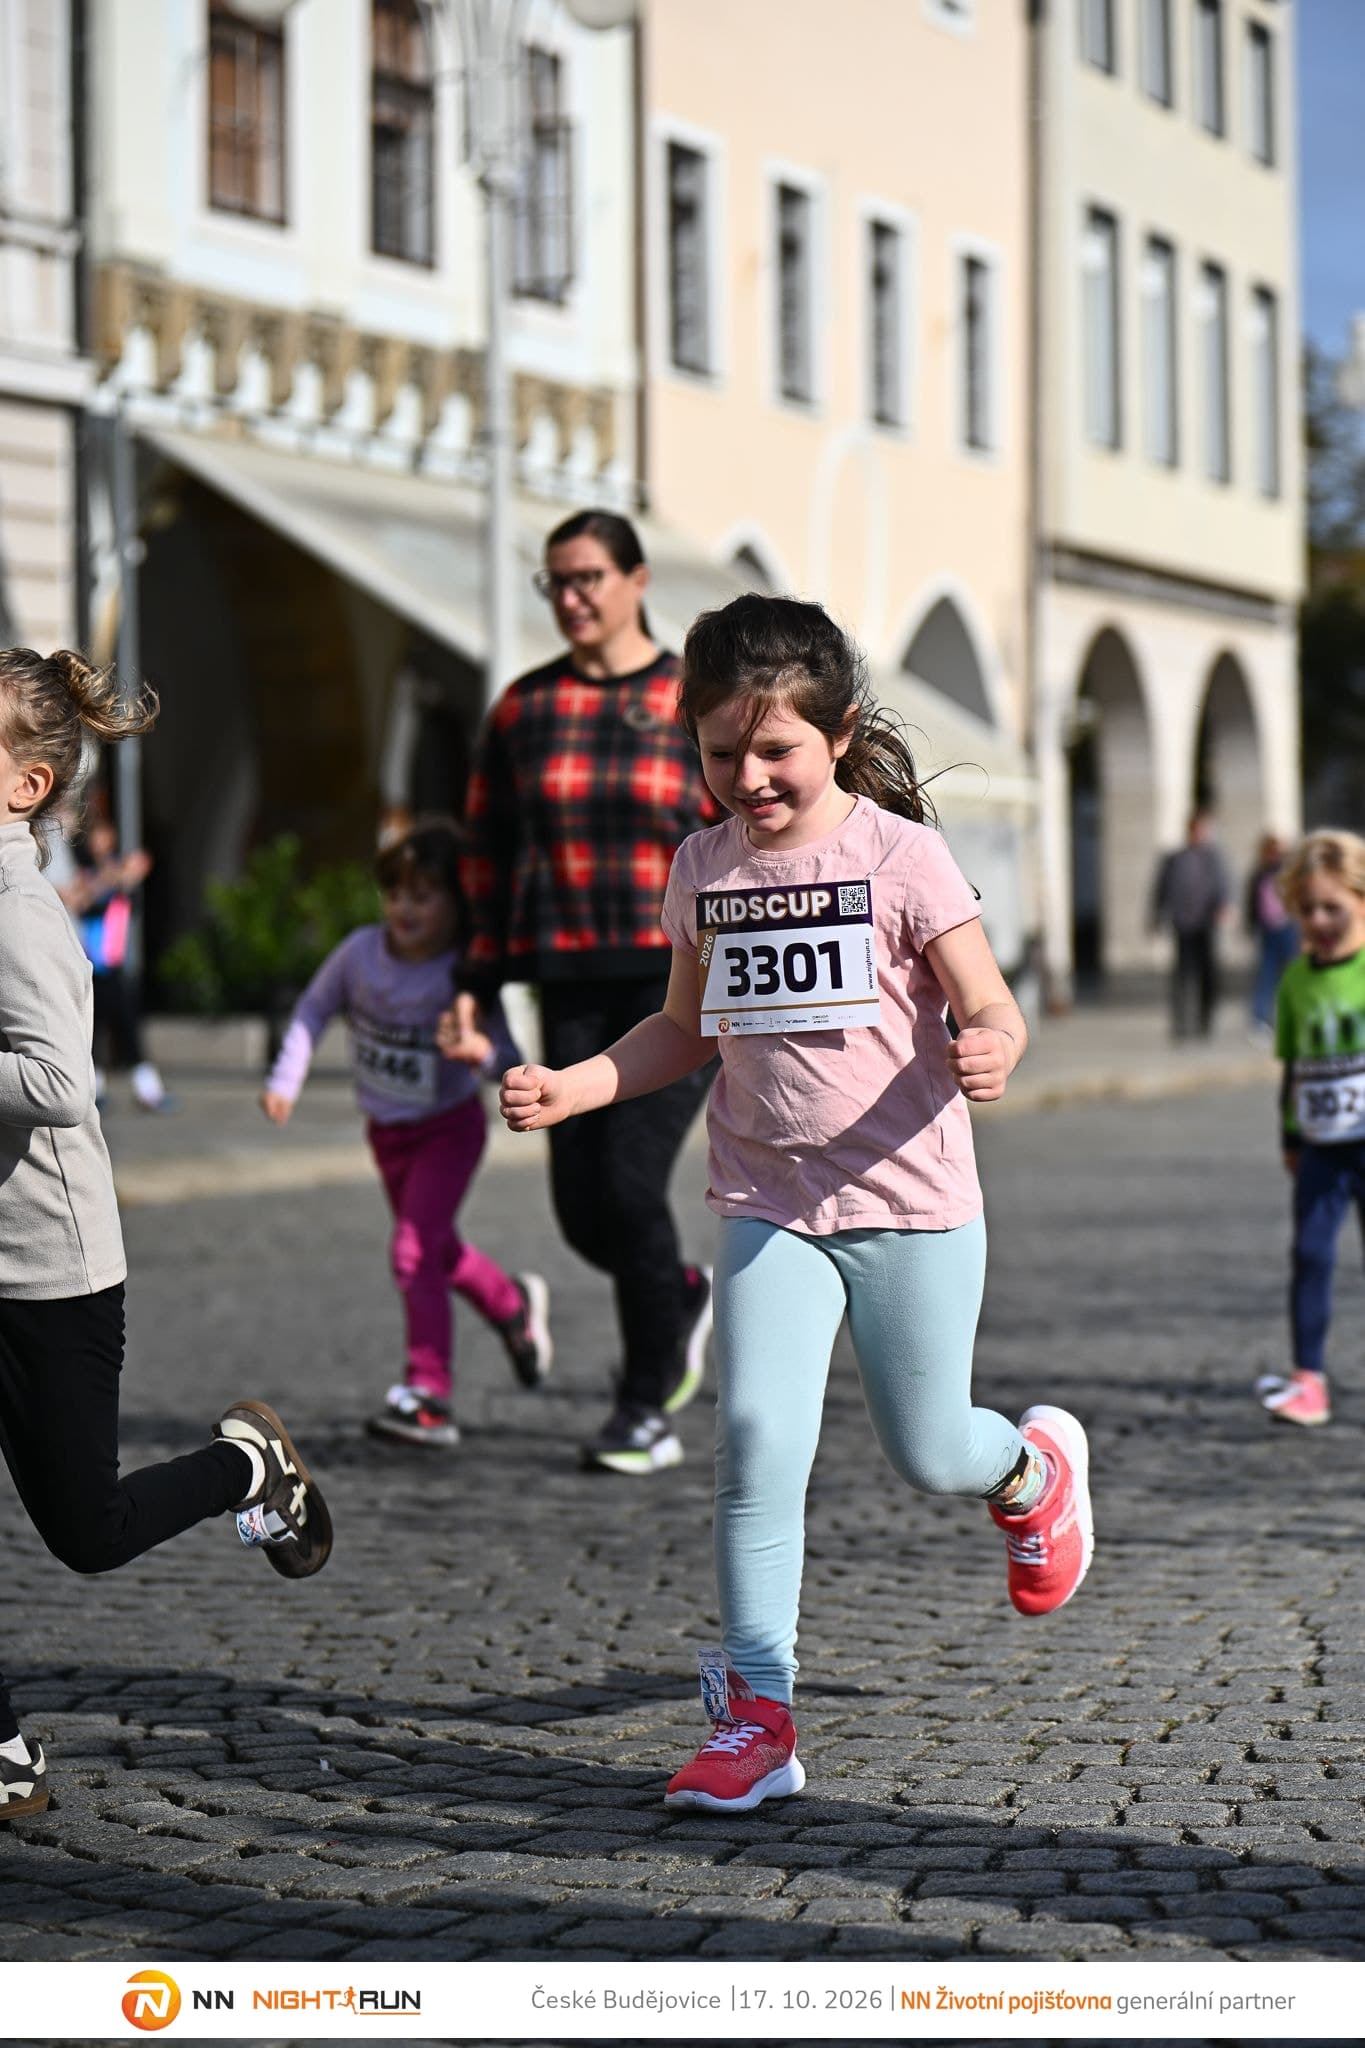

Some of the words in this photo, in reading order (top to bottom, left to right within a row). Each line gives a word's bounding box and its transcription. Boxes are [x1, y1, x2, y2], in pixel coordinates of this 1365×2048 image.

[703, 890, 831, 924] KIDSCUP
[699, 934, 714, 967] 2026
[725, 940, 843, 998] 3301
